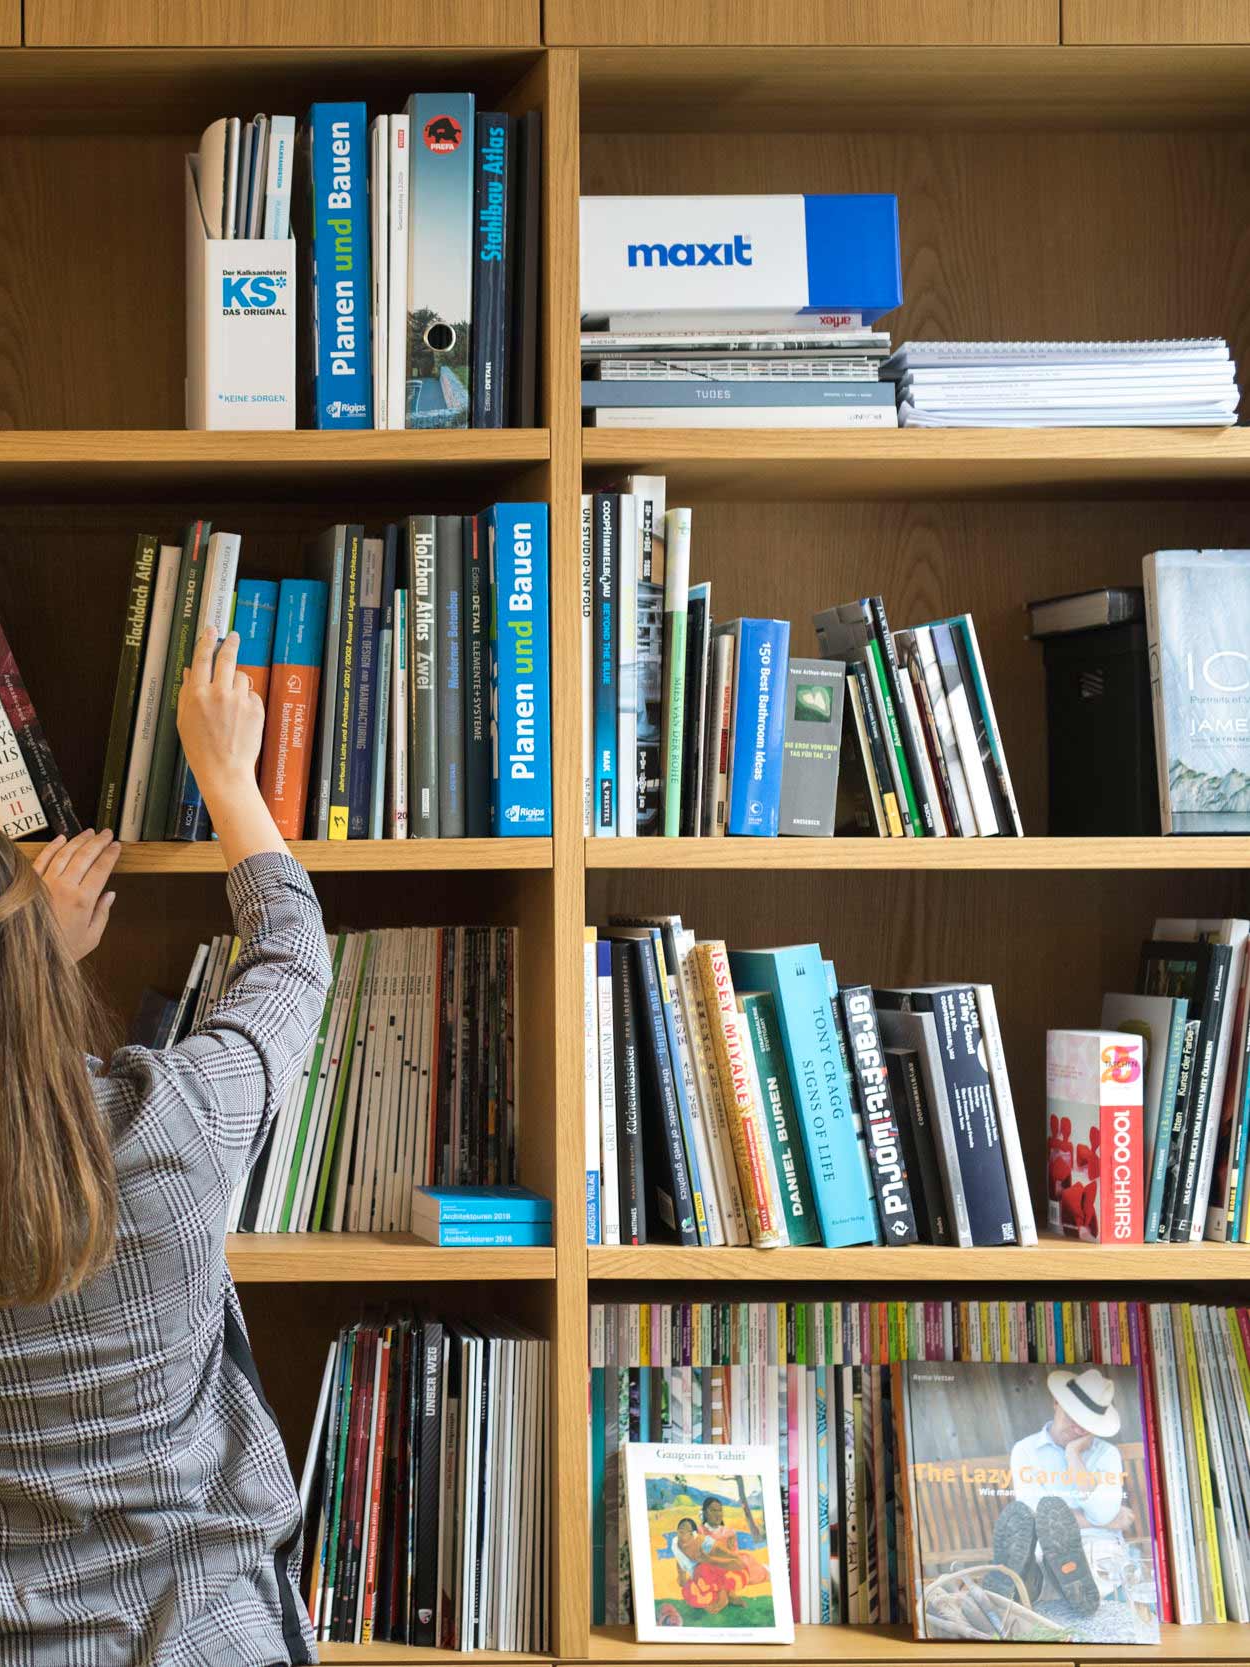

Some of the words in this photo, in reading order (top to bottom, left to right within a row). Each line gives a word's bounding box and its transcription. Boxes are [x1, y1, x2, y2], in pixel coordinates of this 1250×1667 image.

[328, 122, 352, 209] Bauen
[489, 127, 505, 177] Atlas
[480, 181, 502, 261] Stahlbau
[327, 219, 353, 271] und
[628, 234, 752, 267] maxit
[244, 308, 287, 316] ORIGINAL
[330, 280, 356, 376] Planen
[819, 315, 851, 327] arflex
[251, 394, 287, 402] SORGEN.
[342, 403, 366, 413] Rigips
[137, 547, 154, 581] Atlas
[414, 533, 433, 596] Holzbau
[509, 522, 532, 611] Bauen
[126, 582, 150, 648] Flachdach
[416, 600, 435, 641] Atlas
[472, 595, 480, 634] DETAIL
[602, 603, 611, 641] BEYOND
[508, 620, 533, 674] und
[602, 643, 611, 661] THE
[759, 642, 771, 664] 150
[417, 650, 434, 689] Zwei
[602, 663, 611, 685] BLUE
[758, 667, 770, 691] Best
[473, 640, 482, 741] ELEMENTE+SYSTEME
[291, 704, 306, 748] Frick/Knöll
[511, 683, 534, 779] Planen
[754, 694, 768, 748] Bathroom
[1190, 719, 1249, 736] JAME
[274, 703, 293, 795] Baukonstruktionslehre
[602, 750, 611, 772] MAK
[753, 751, 765, 780] Ideas
[3, 813, 45, 837] EXPE
[520, 807, 544, 817] Rigips
[602, 790, 611, 823] PRESTEL
[711, 951, 735, 1018] ISSEY
[723, 1022, 751, 1108] MIYAKE
[1183, 1029, 1194, 1054] Farbe
[813, 1006, 830, 1055] TONY
[822, 1060, 844, 1120] CRAGG
[1182, 1054, 1191, 1070] der
[625, 1045, 639, 1136] Küchenklassiker
[802, 1060, 821, 1110] SIGNS
[1178, 1071, 1190, 1097] Kunst
[766, 1077, 790, 1142] BUREN
[814, 1114, 829, 1138] OF
[1172, 1111, 1184, 1133] Itten
[1113, 1110, 1130, 1163] 1000
[819, 1140, 836, 1182] LIFE
[777, 1149, 805, 1217] DANIEL
[1113, 1168, 1132, 1240] CHAIRS
[427, 1347, 438, 1379] WEG
[426, 1382, 436, 1417] UNSER
[656, 1448, 702, 1461] Gauguin
[704, 1450, 714, 1461] in
[717, 1450, 746, 1461] Tahiti
[915, 1464, 956, 1482] The
[962, 1464, 1012, 1488] Lazy
